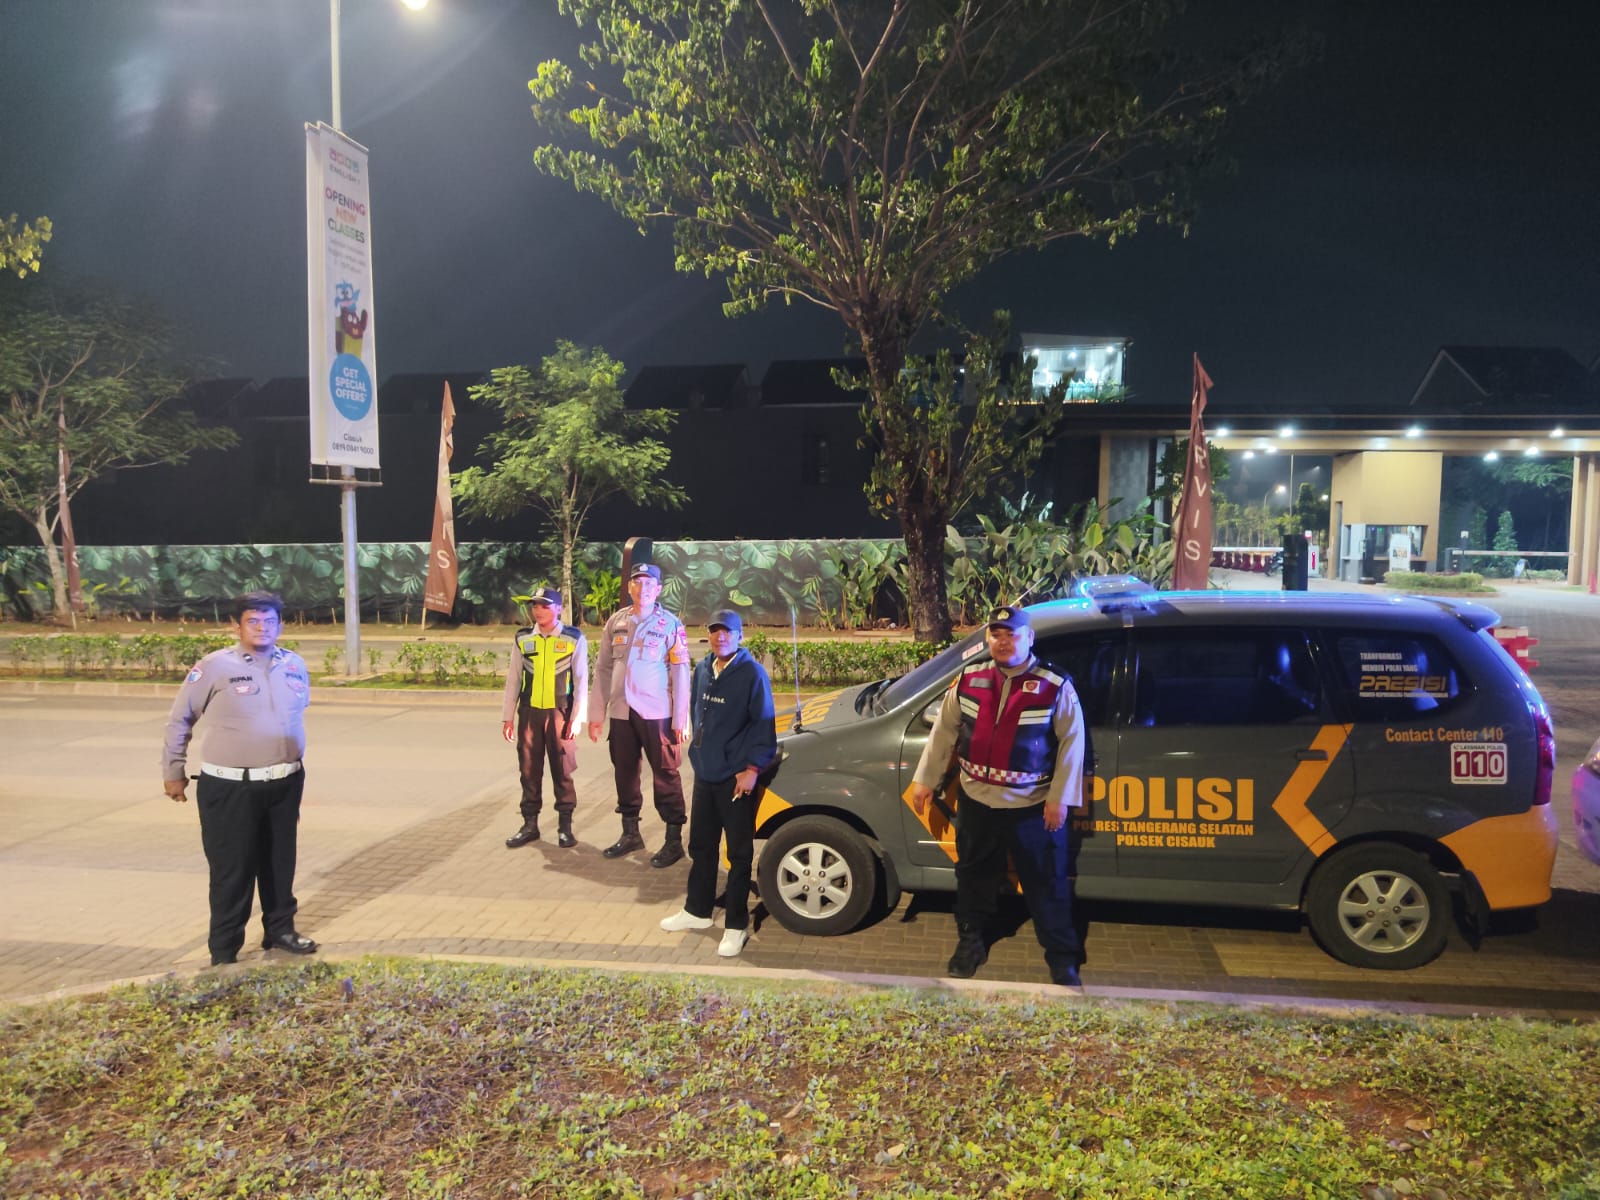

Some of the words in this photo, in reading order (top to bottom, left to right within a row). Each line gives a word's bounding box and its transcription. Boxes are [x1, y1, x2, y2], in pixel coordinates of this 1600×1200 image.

[325, 187, 366, 216] OPENING
[328, 218, 365, 243] CLASSES
[343, 367, 359, 379] GET
[335, 376, 367, 392] SPECIAL
[1385, 727, 1434, 742] Contact
[1437, 727, 1478, 741] Center
[1481, 727, 1504, 741] 110
[1456, 753, 1504, 776] 110
[1073, 775, 1255, 821] POLISI
[1121, 821, 1197, 834] TANGERANG
[1199, 822, 1254, 836] SELATAN
[1116, 834, 1165, 847] POLSEK
[1166, 835, 1216, 848] CISAUK
